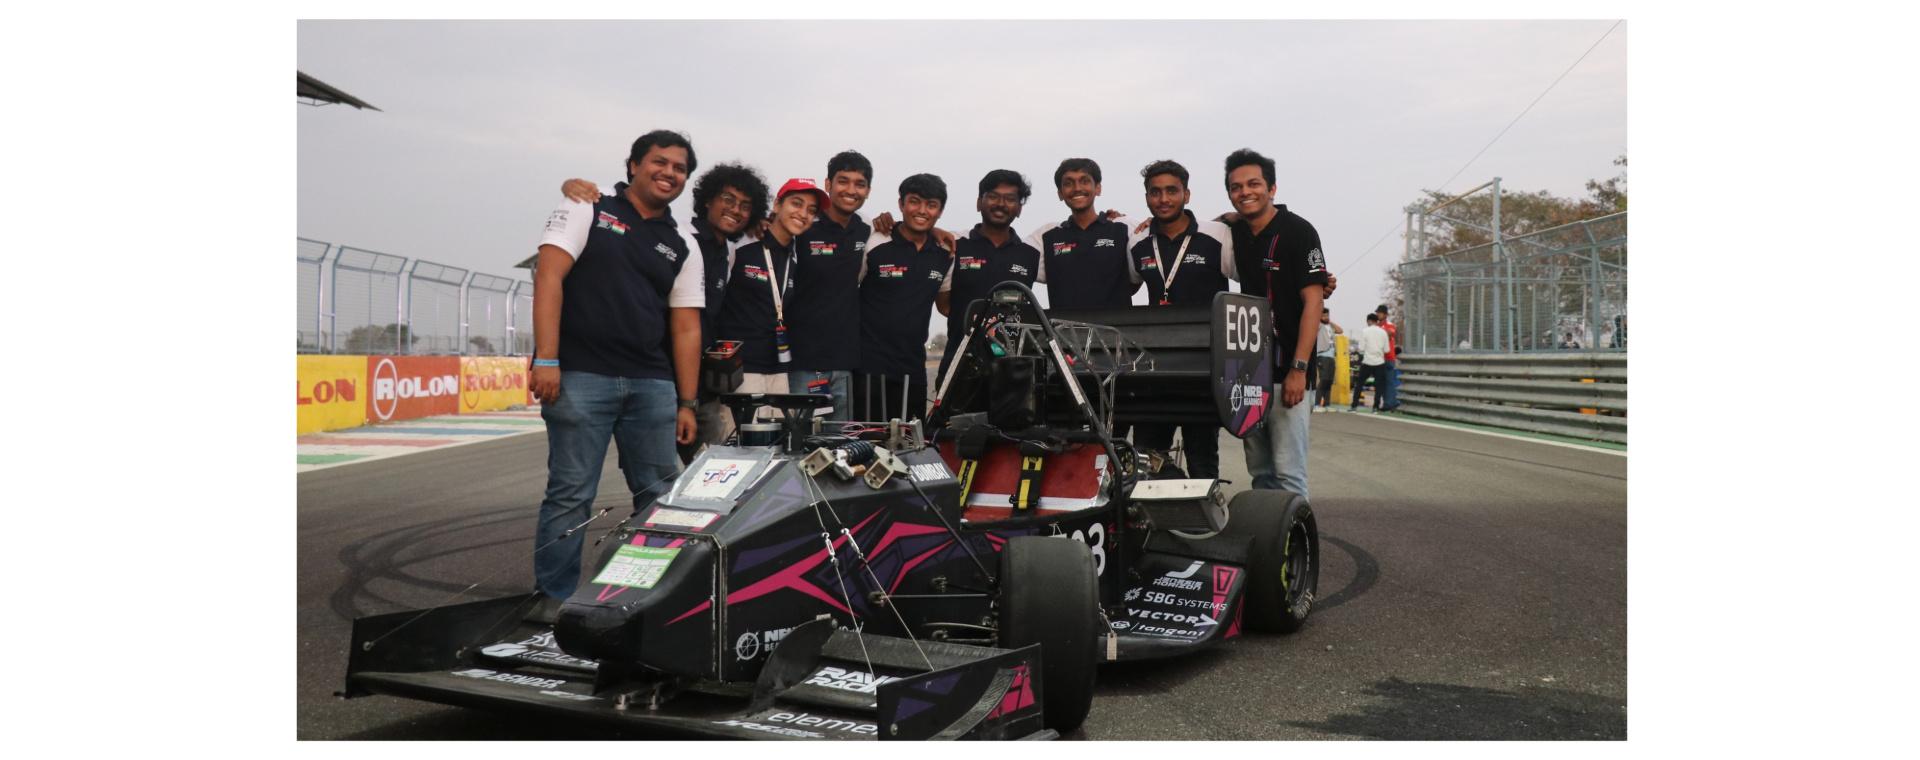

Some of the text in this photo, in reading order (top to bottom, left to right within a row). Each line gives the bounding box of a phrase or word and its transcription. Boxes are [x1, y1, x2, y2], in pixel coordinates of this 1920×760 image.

[1227, 304, 1261, 352] E03
[376, 375, 459, 400] ROLON
[465, 373, 524, 392] ROLON
[1244, 385, 1262, 397] NRB
[1143, 591, 1228, 611] SBG SYSTEMS
[1127, 608, 1200, 624] VECTOR
[1138, 624, 1205, 637] tangent
[768, 712, 878, 735] eleme
